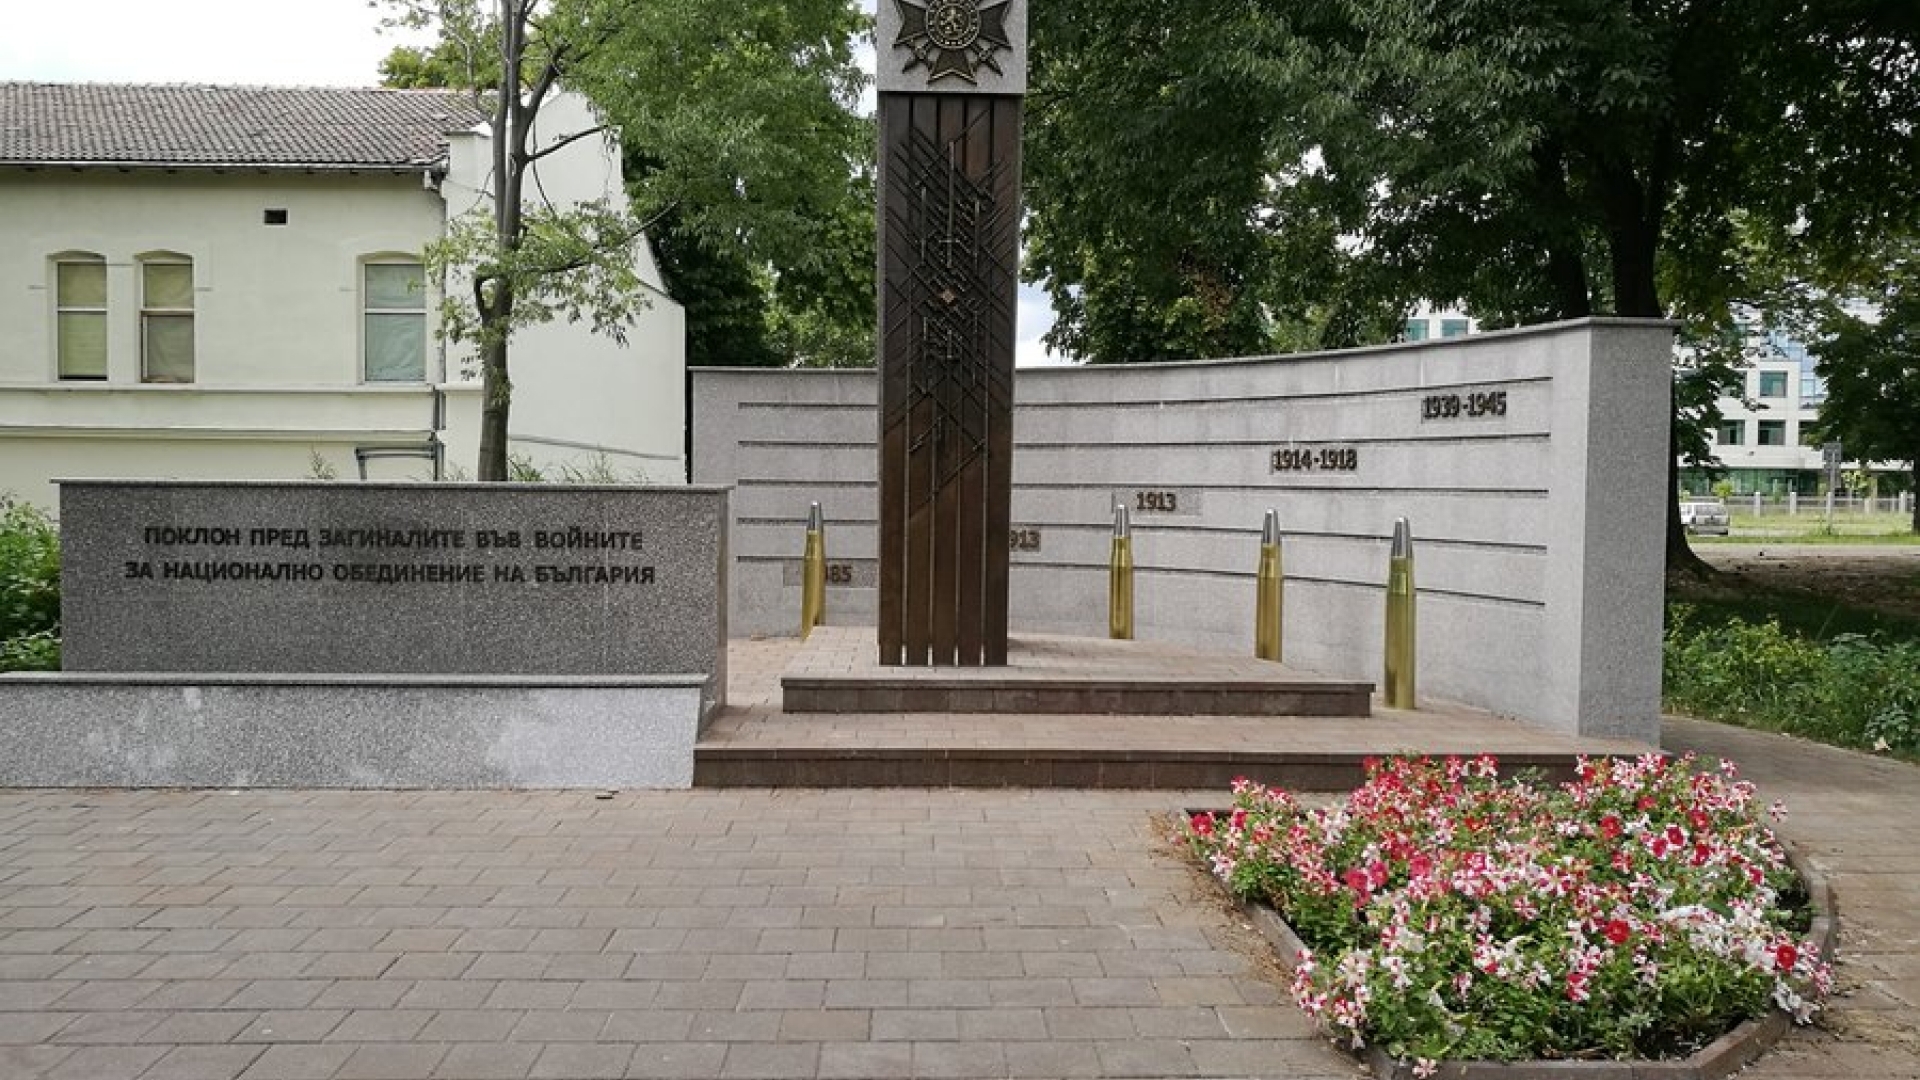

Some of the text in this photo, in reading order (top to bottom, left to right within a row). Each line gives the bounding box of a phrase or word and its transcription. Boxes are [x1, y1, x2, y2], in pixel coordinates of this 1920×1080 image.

[1273, 449, 1357, 471] 1914-1918
[1137, 492, 1176, 511] 1913
[144, 526, 643, 550] ПОКЛОН ПРЕД ЗАГИНАЛИТЕ ВЪВ ВОЙНИТЕ
[1009, 530, 1040, 548] 913
[125, 562, 656, 585] ЗА НАЦИОНАЛНО ОБЕДИНЕНИЕ НА БЪЛГАРИЯ
